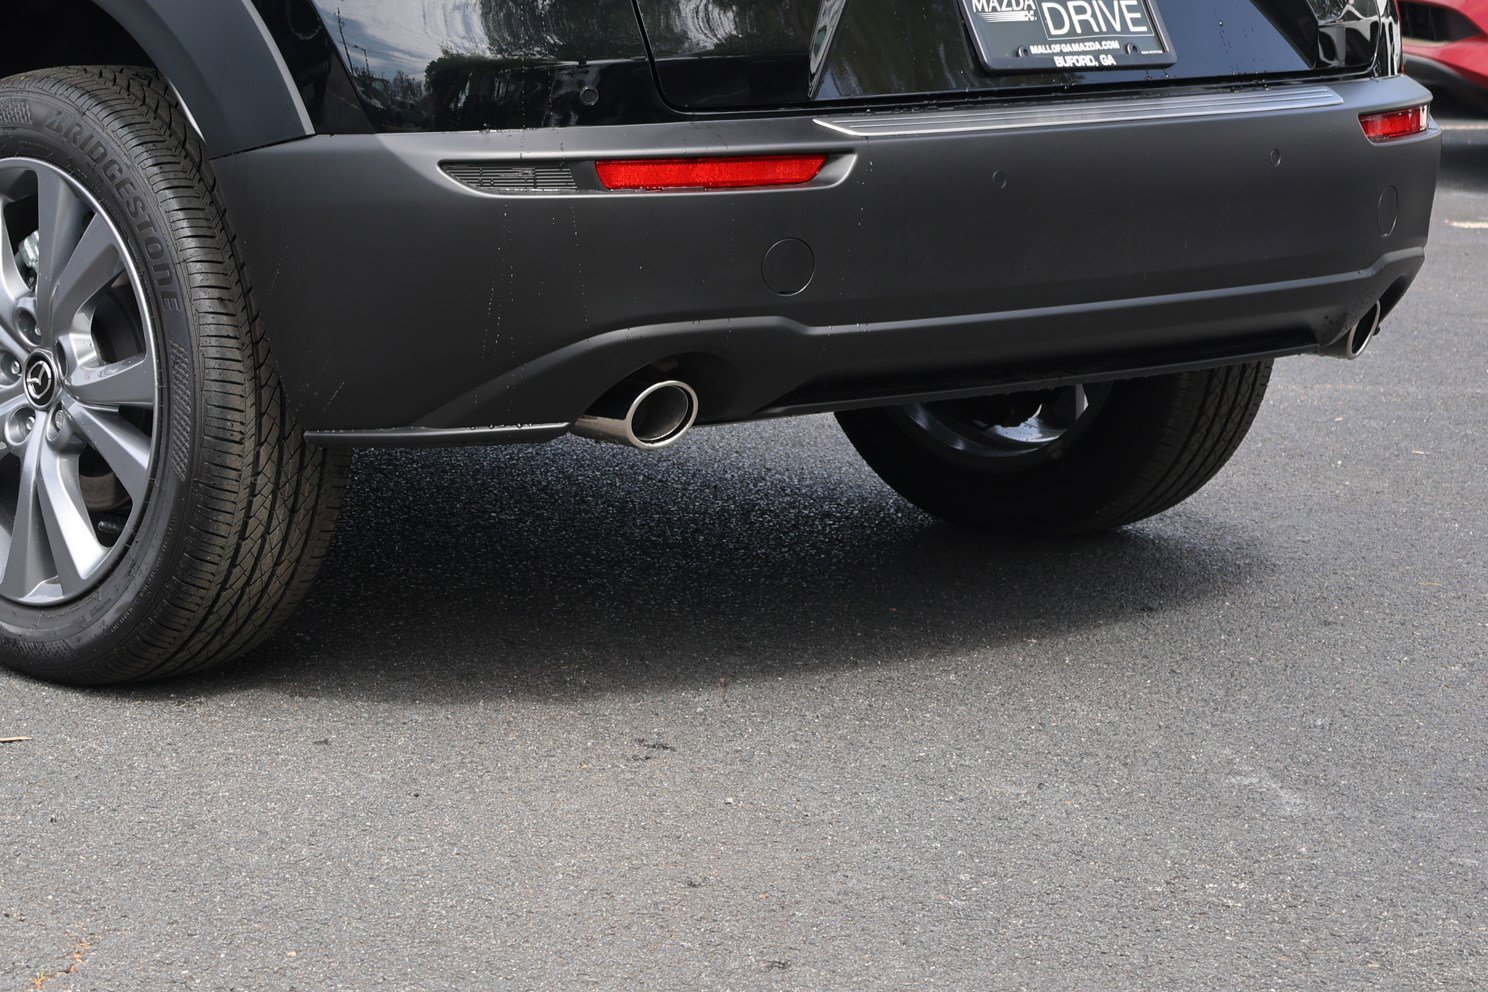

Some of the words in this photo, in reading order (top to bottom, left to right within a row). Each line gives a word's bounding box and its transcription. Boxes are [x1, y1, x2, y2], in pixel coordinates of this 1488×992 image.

[1041, 0, 1147, 35] DRIVE
[1053, 55, 1098, 67] BUFORD,
[1100, 54, 1117, 66] GA
[41, 107, 181, 313] BRIDGESTONE
